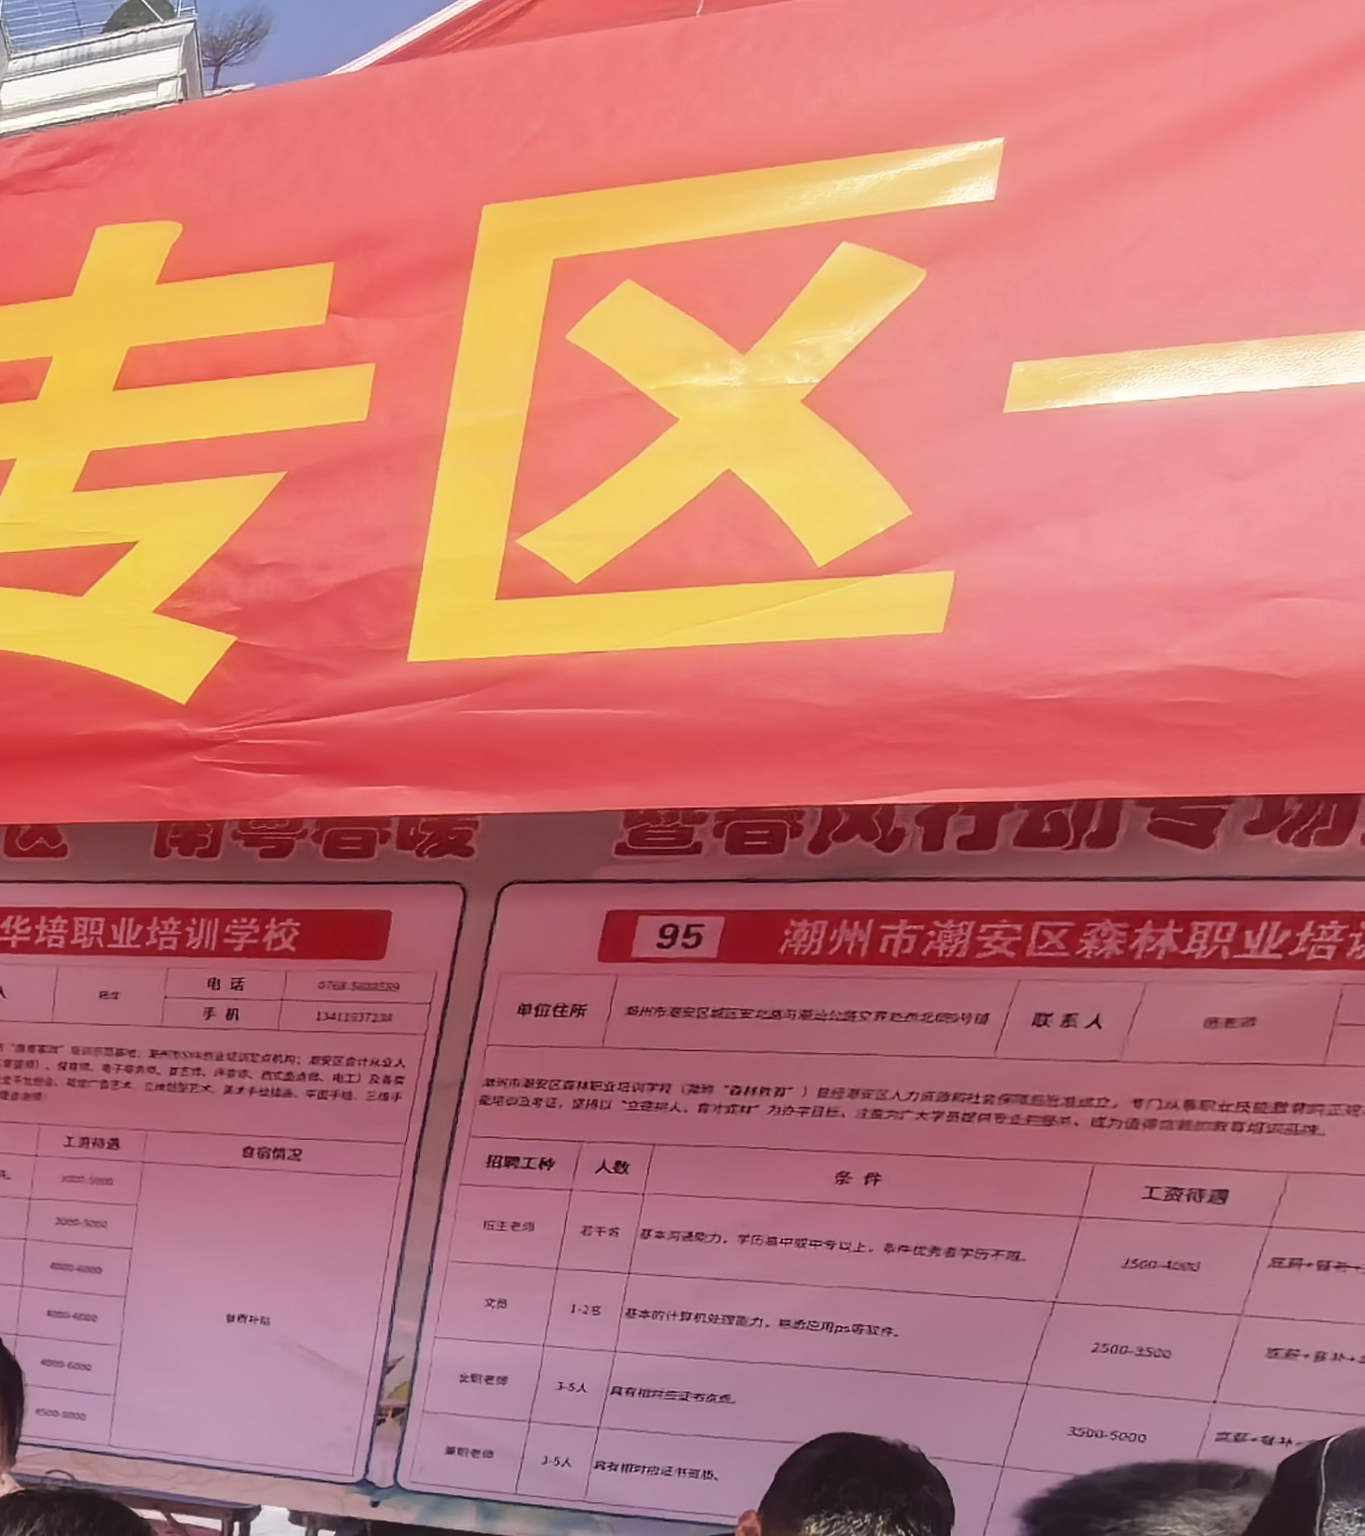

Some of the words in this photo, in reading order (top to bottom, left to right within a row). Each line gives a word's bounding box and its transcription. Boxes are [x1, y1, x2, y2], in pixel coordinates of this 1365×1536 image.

[612, 796, 1365, 857] 暨春风行动专场
[656, 923, 706, 949] 95
[207, 976, 245, 992] 电话
[202, 1005, 240, 1021] 手机
[516, 1002, 588, 1019] 单位住所
[1031, 1011, 1104, 1030] 联系人
[485, 1153, 556, 1172] 招聘工种
[594, 1159, 631, 1176] 人数
[833, 1169, 883, 1187] 条件
[1140, 1184, 1231, 1206] 工资待遇
[483, 1297, 508, 1311] 文员
